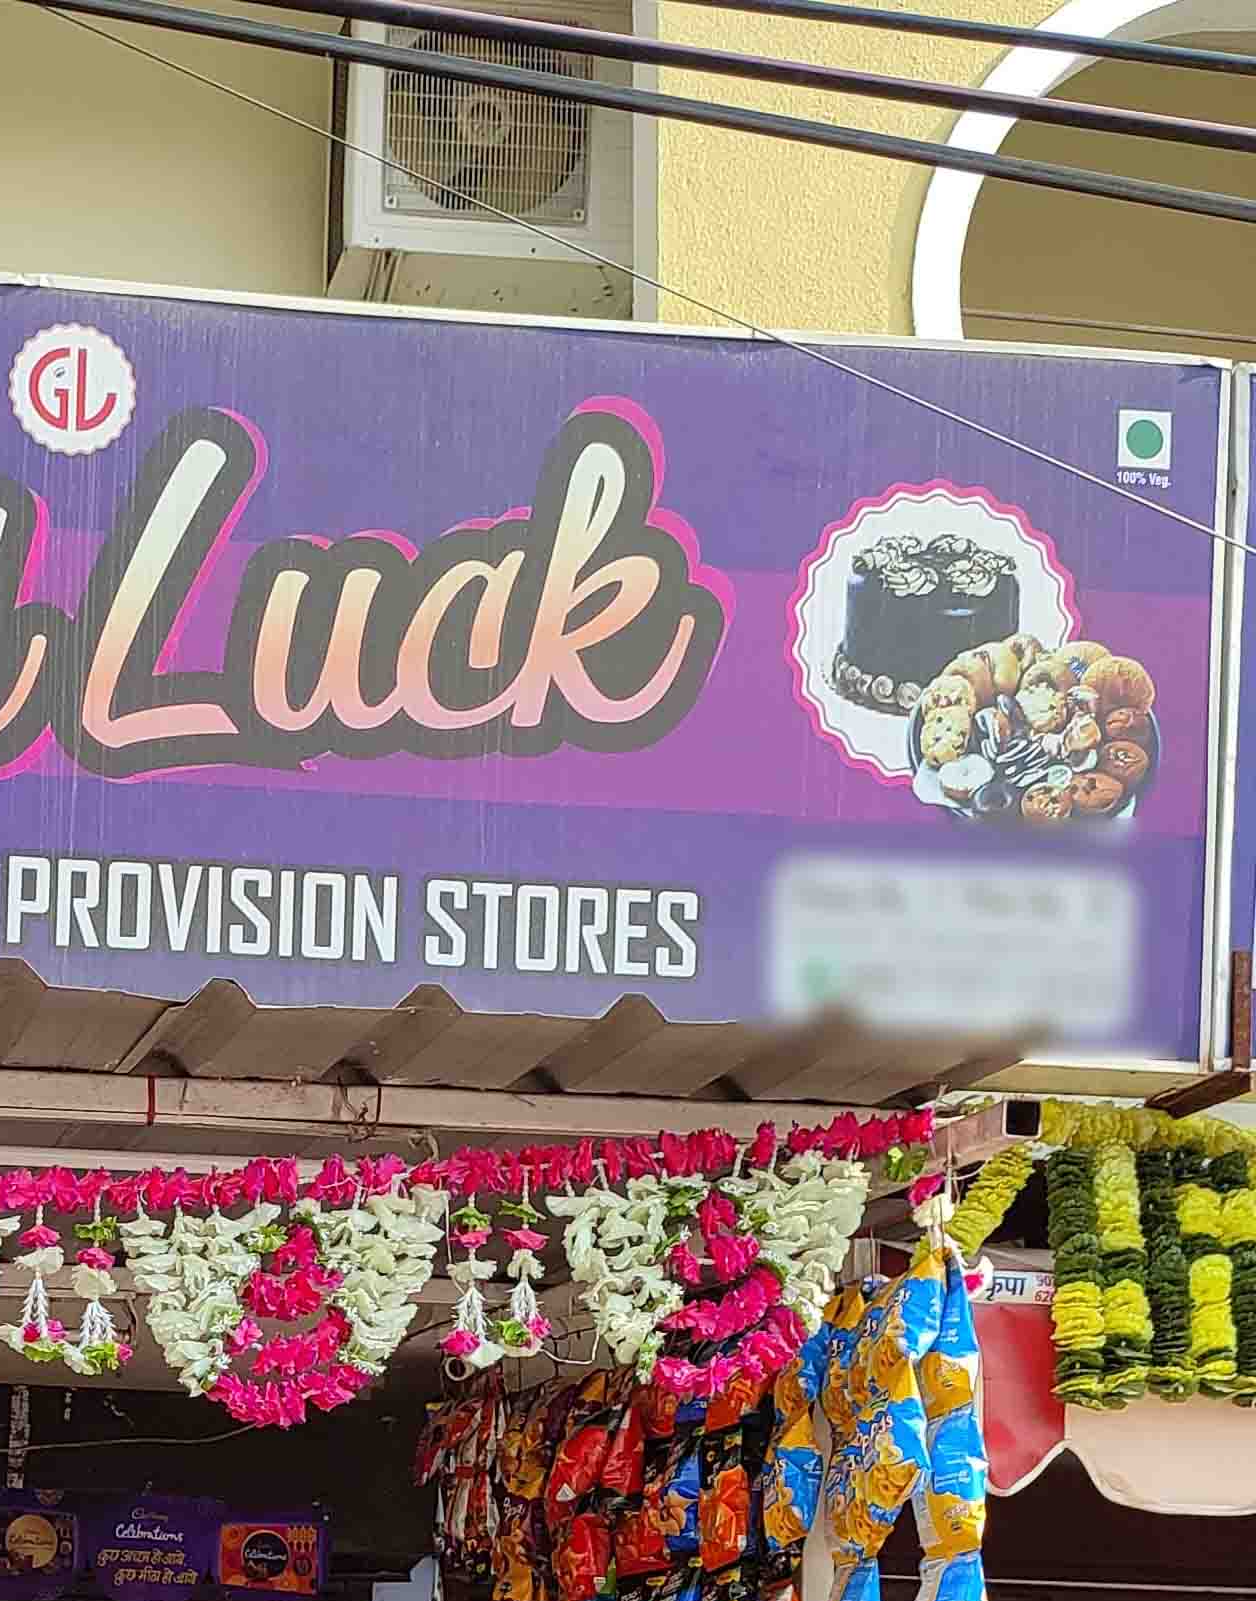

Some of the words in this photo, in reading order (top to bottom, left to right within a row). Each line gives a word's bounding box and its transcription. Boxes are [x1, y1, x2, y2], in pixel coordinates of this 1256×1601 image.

[29, 347, 116, 431] GL
[1116, 471, 1147, 485] 100%
[81, 438, 695, 749] Luck
[6, 855, 398, 963] PROVISION
[424, 879, 699, 979] STORES
